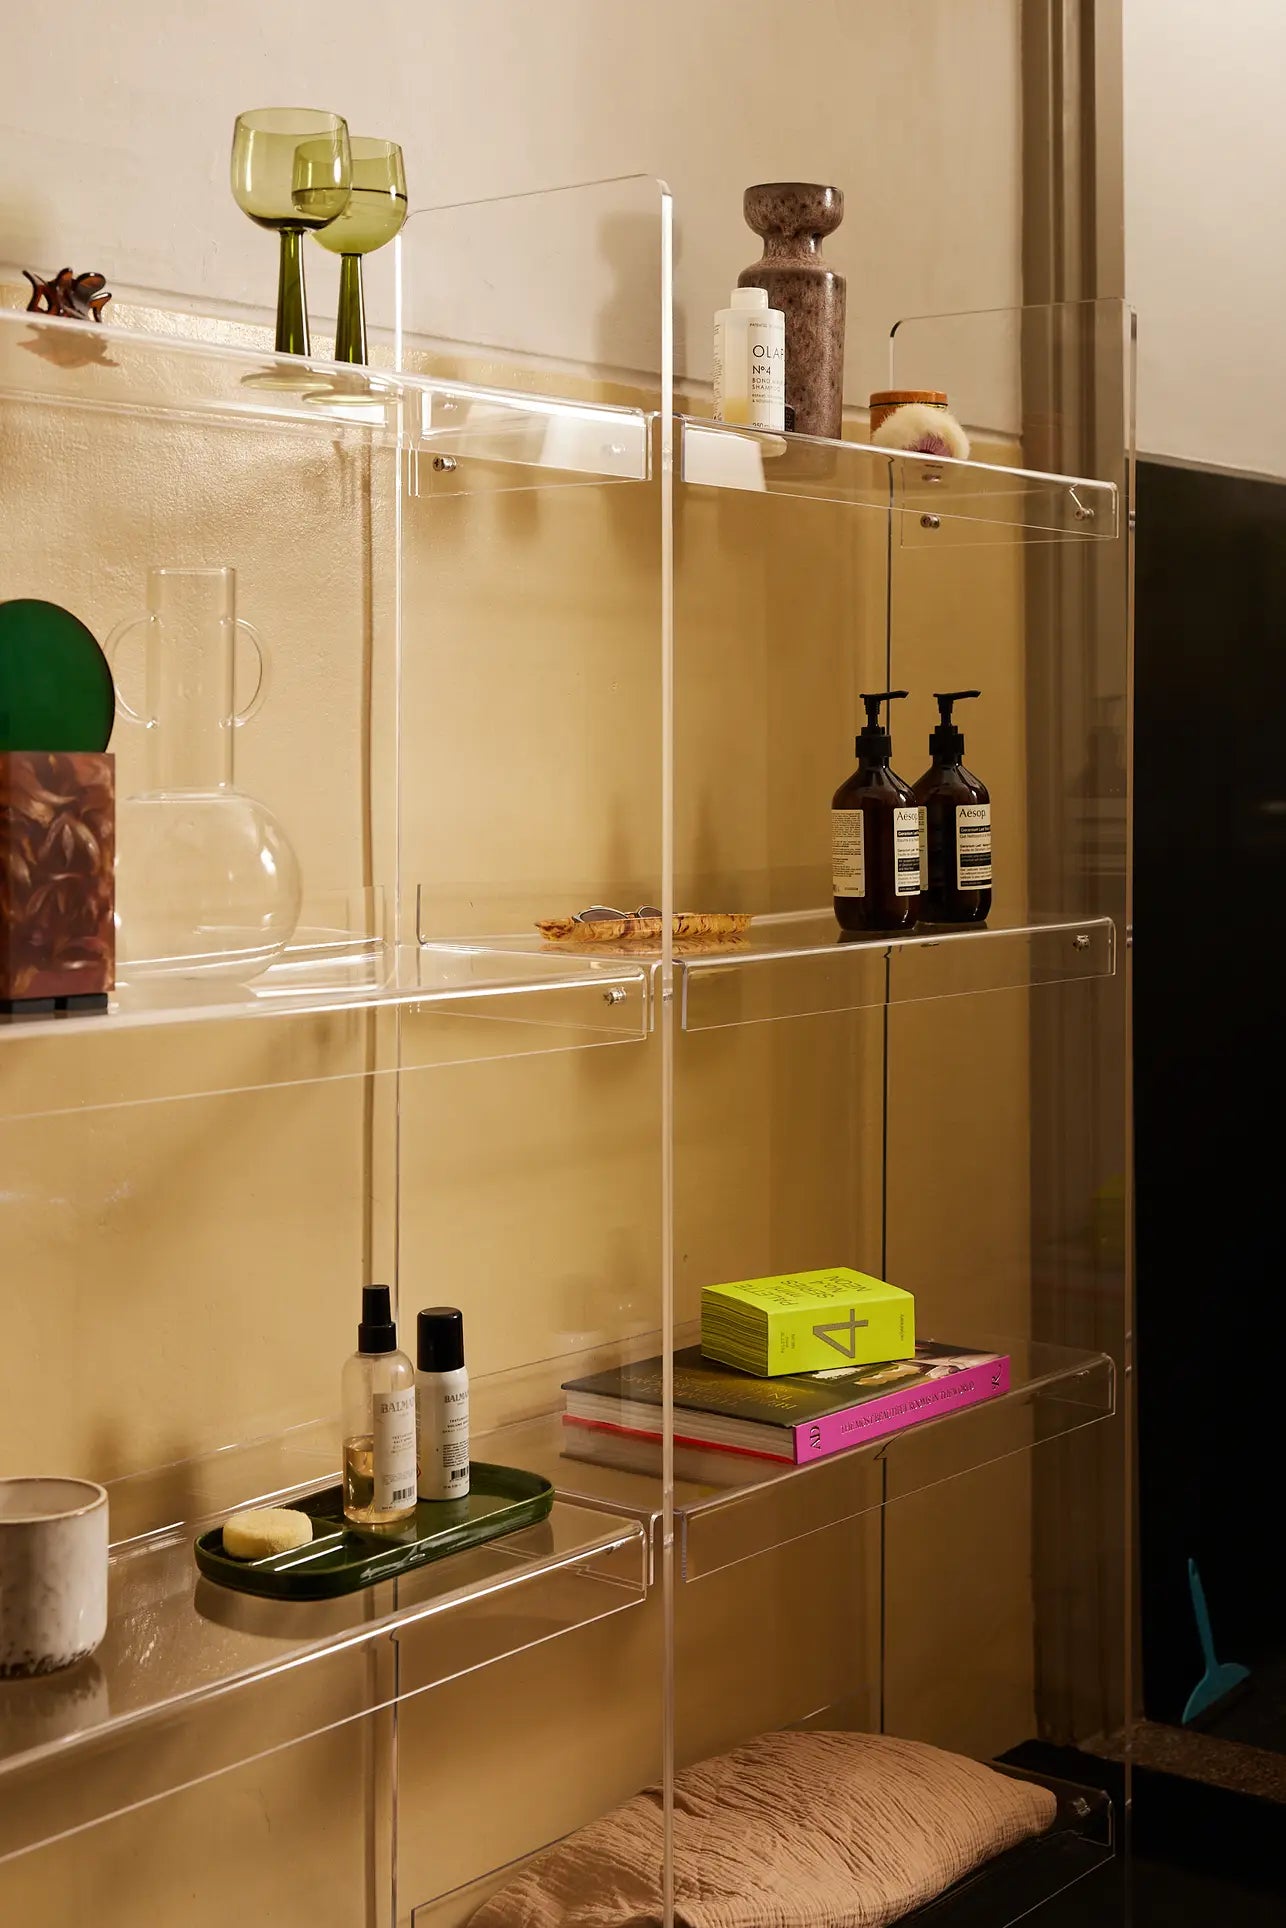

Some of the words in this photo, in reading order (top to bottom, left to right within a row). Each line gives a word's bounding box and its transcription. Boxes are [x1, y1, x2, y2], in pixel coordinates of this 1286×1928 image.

[780, 1280, 836, 1299] SERIES
[824, 1275, 873, 1293] NEON
[813, 1308, 869, 1359] 4
[809, 1425, 821, 1450] AD
